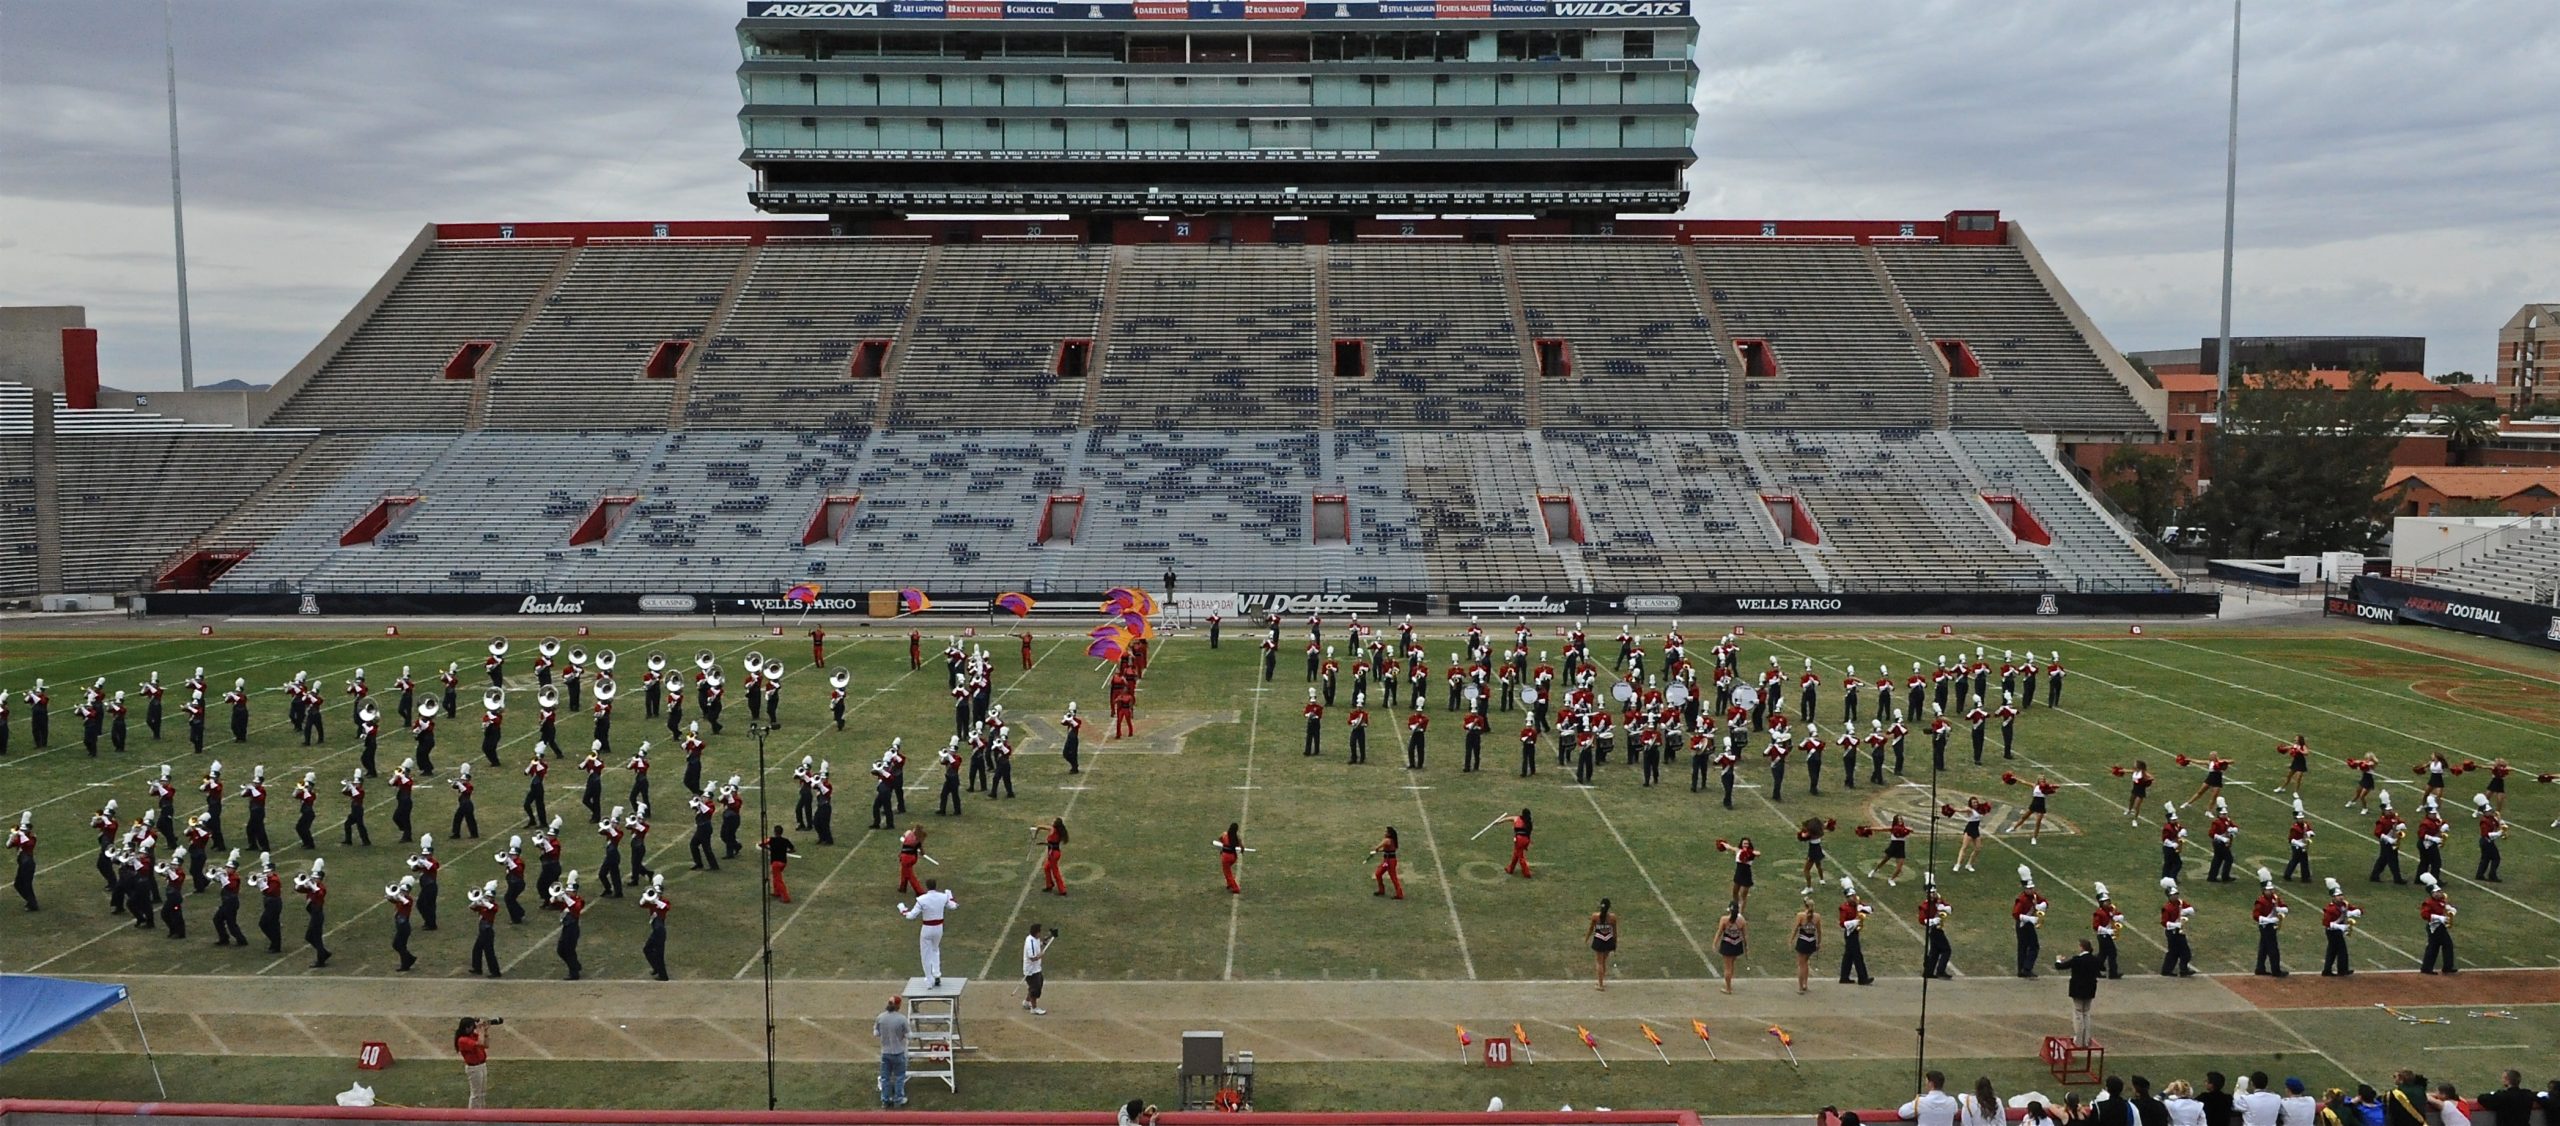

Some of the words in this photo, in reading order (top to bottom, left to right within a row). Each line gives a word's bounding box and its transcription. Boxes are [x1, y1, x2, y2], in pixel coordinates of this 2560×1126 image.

[760, 4, 878, 17] ARIZONA
[902, 5, 914, 13] ART
[915, 5, 944, 13] LUPPINO
[1012, 6, 1035, 14] CHUCK
[1555, 3, 1683, 16] WILDCATS
[502, 229, 512, 238] 17
[655, 228, 667, 237] 18
[831, 227, 841, 236] 19
[1027, 227, 1041, 235] 20
[1177, 226, 1189, 235] 21
[1401, 226, 1414, 235] 22
[1600, 227, 1613, 235] 23
[1762, 227, 1775, 236] 24
[1901, 228, 1914, 236] 25
[137, 397, 148, 405] 16
[299, 595, 320, 614] A
[519, 595, 585, 613] Bashas'
[751, 599, 803, 609] WELLS
[1222, 600, 1234, 609] DAY
[1736, 599, 1789, 610] WELLS
[1791, 599, 1841, 610] FARGO
[2037, 595, 2058, 614] A
[2329, 600, 2356, 613] BEAR
[2357, 605, 2393, 621] DOWN
[2445, 603, 2501, 624] FOOTBALL
[361, 1045, 380, 1066] 40
[1488, 1042, 1507, 1062] 40
